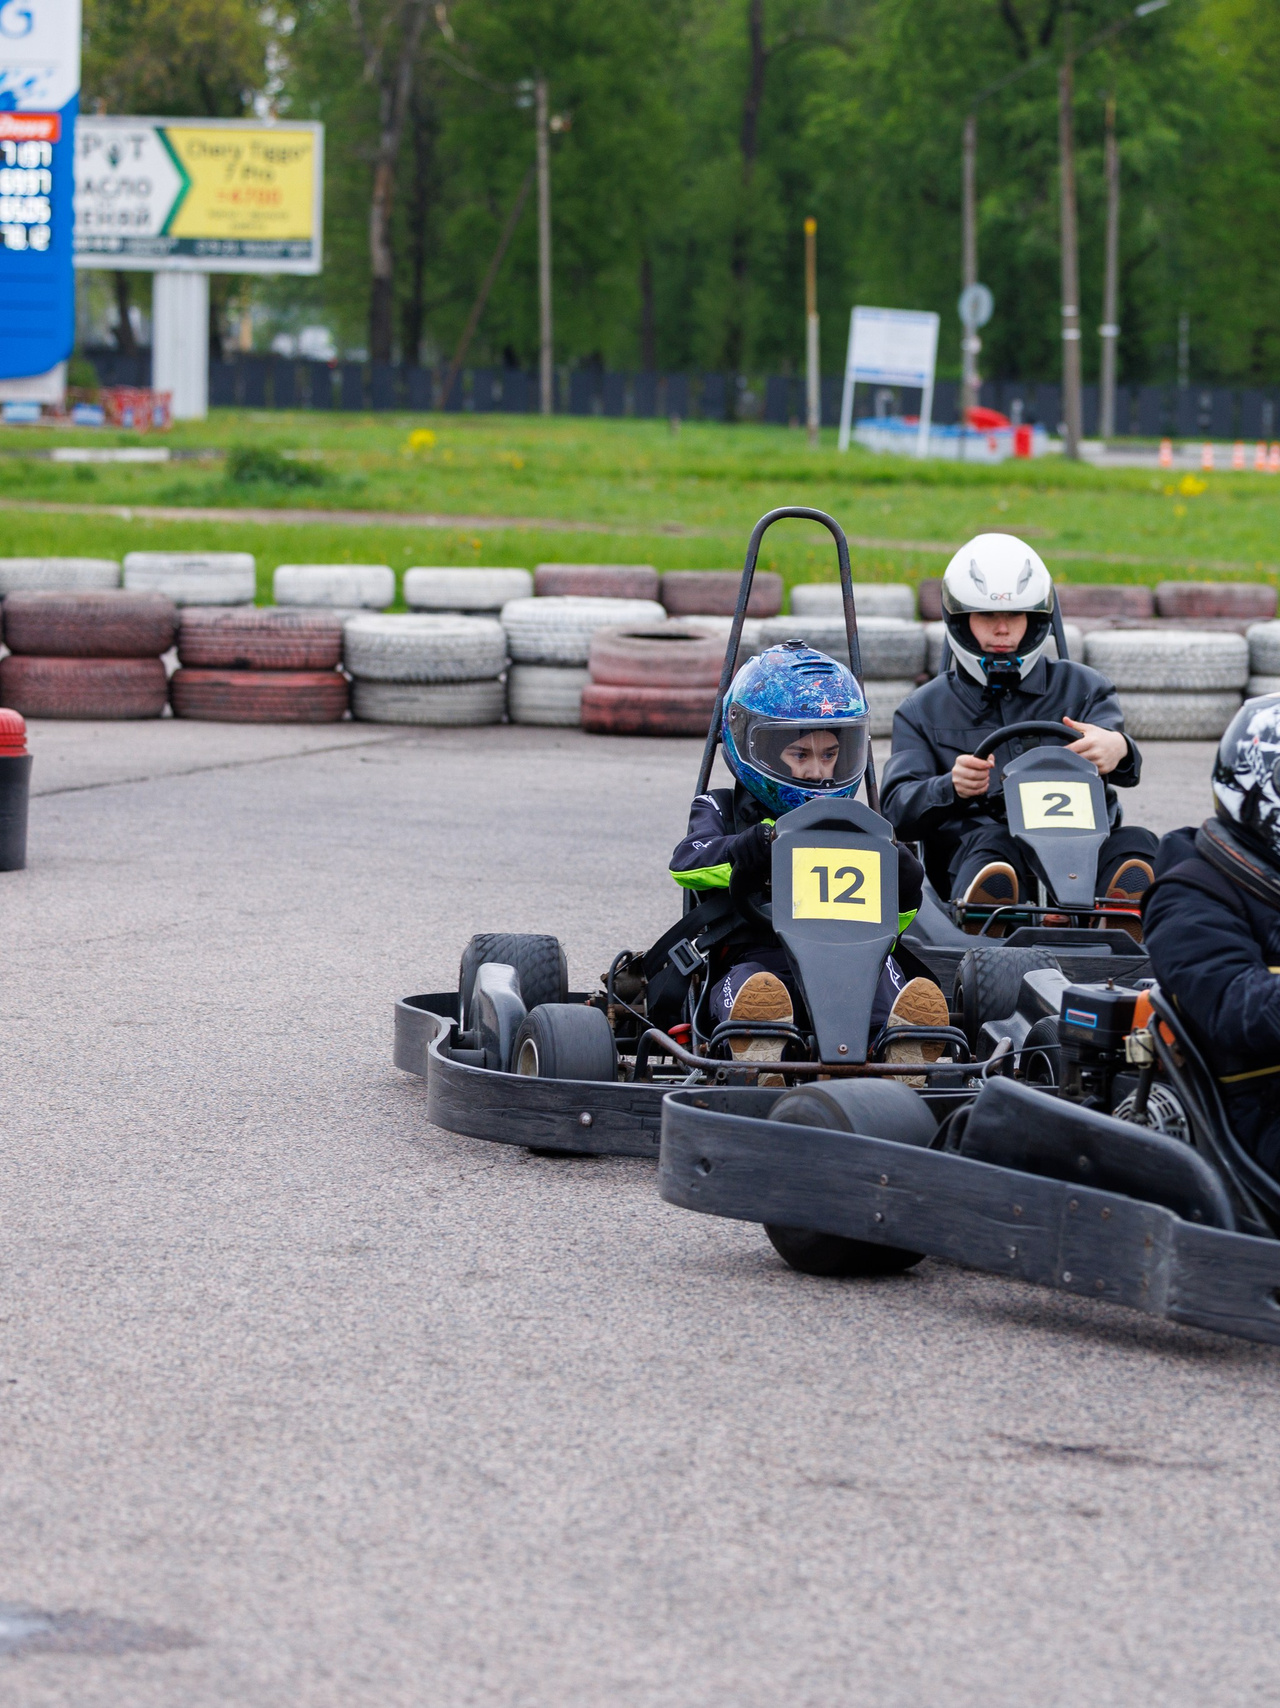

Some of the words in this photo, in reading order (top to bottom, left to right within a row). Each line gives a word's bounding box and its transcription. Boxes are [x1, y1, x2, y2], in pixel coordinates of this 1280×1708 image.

[989, 592, 1013, 602] GXT
[1043, 792, 1074, 817] 2
[810, 866, 866, 905] 12
